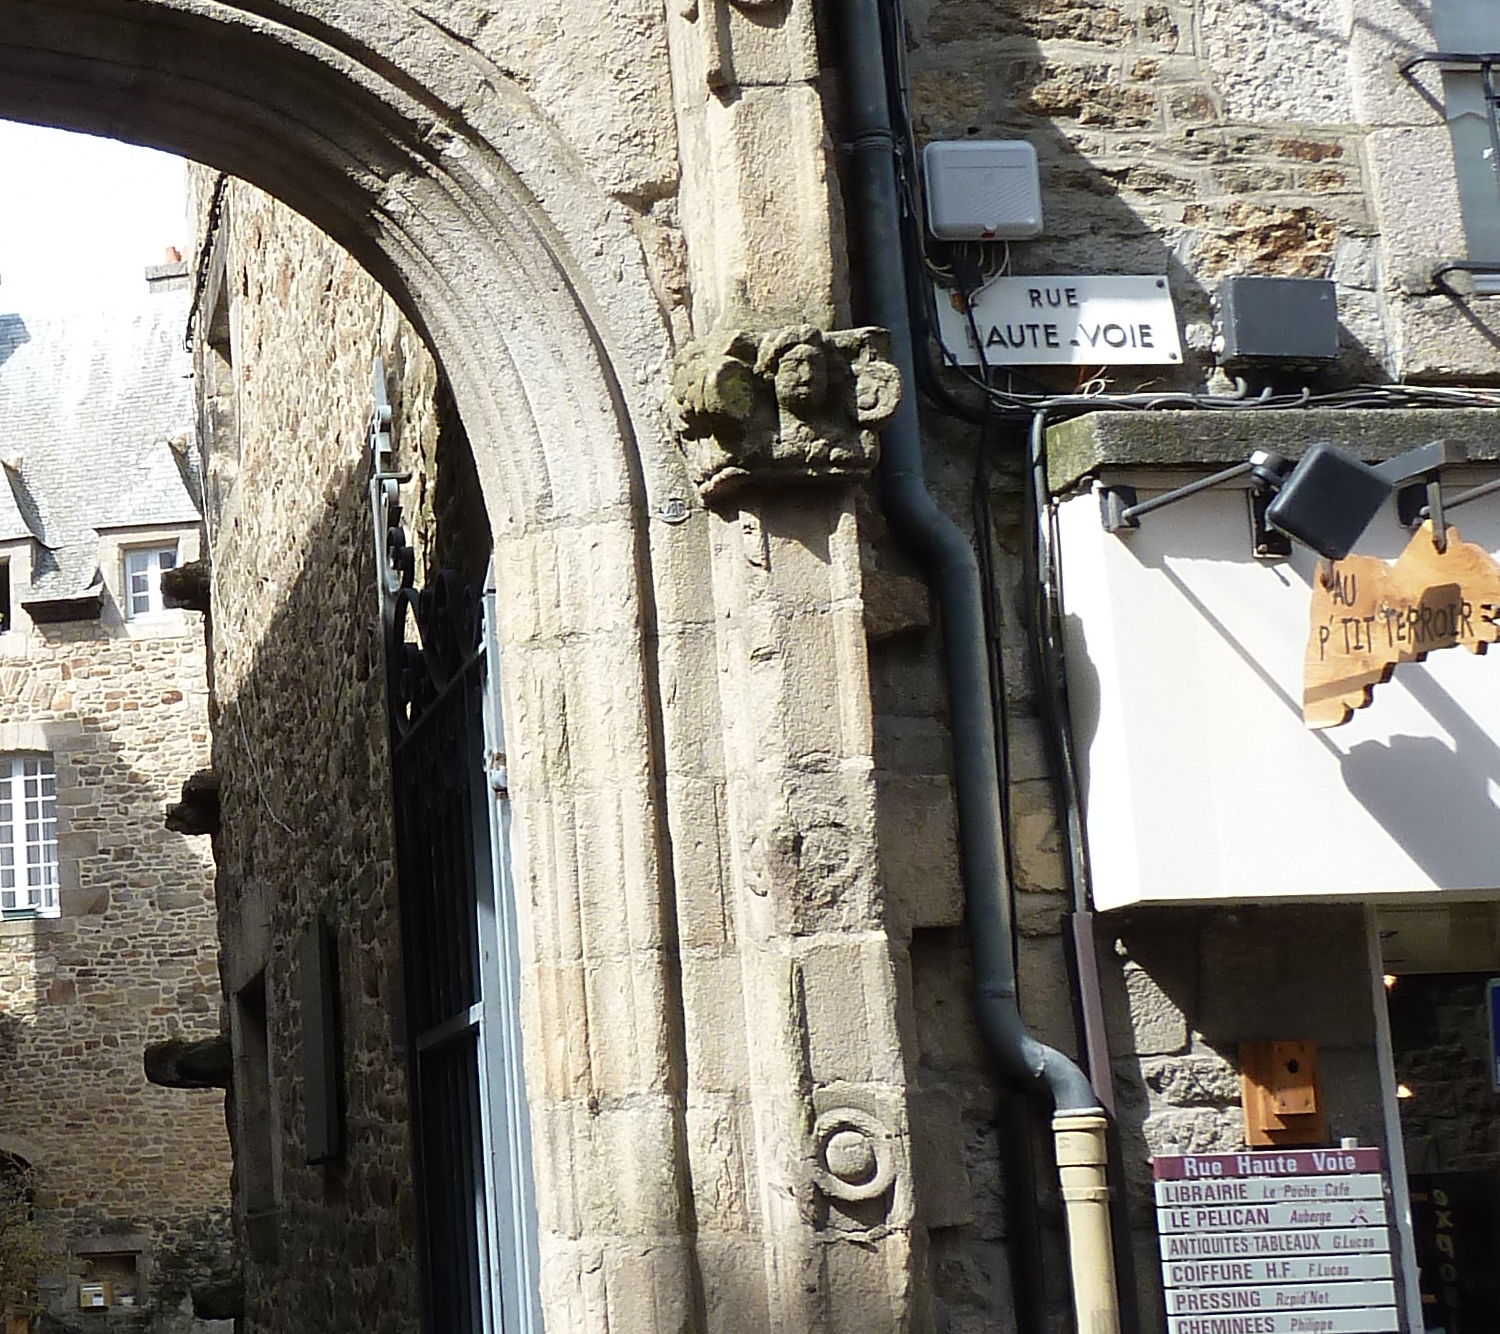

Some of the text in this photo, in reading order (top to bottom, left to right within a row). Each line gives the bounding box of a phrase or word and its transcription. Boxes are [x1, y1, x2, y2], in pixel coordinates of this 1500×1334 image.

[1028, 288, 1079, 307] RUE
[1079, 324, 1155, 348] VOIE
[1333, 571, 1357, 606] AU
[1382, 598, 1475, 648] TERROIR
[1184, 1152, 1357, 1177] Rue Haute Voie
[1165, 1184, 1248, 1203] LIBRAIRIE
[1263, 1185, 1275, 1199] Le
[1171, 1208, 1332, 1228] LE PELICAN Auberge
[1169, 1235, 1376, 1256] ANTIQUITES-TABLEAUX G.Lucas
[1172, 1263, 1253, 1282] COIFFURE
[1308, 1263, 1350, 1277] F.Lucas
[1176, 1291, 1261, 1310] PRESSING
[1290, 1318, 1334, 1333] Philippe
